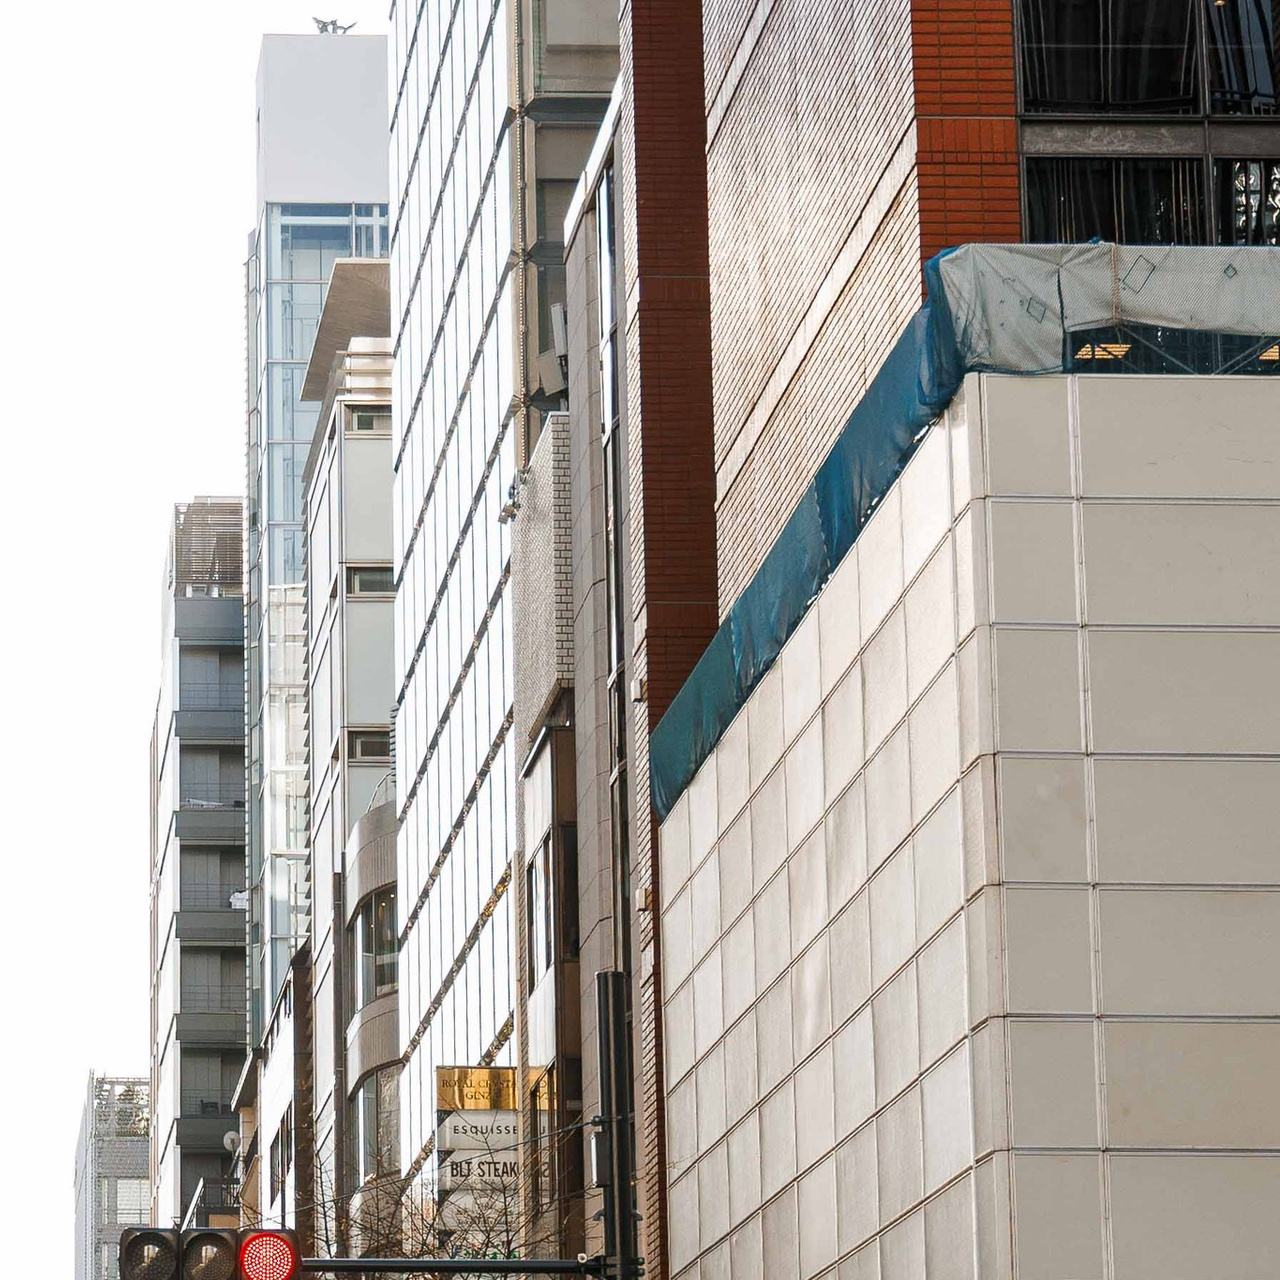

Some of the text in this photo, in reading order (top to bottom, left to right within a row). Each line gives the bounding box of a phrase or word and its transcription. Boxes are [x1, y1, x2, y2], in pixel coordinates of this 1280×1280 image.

[442, 1079, 475, 1089] ROYAL
[453, 1125, 518, 1136] ESQUISSE
[450, 1161, 518, 1178] BLT STEAK
